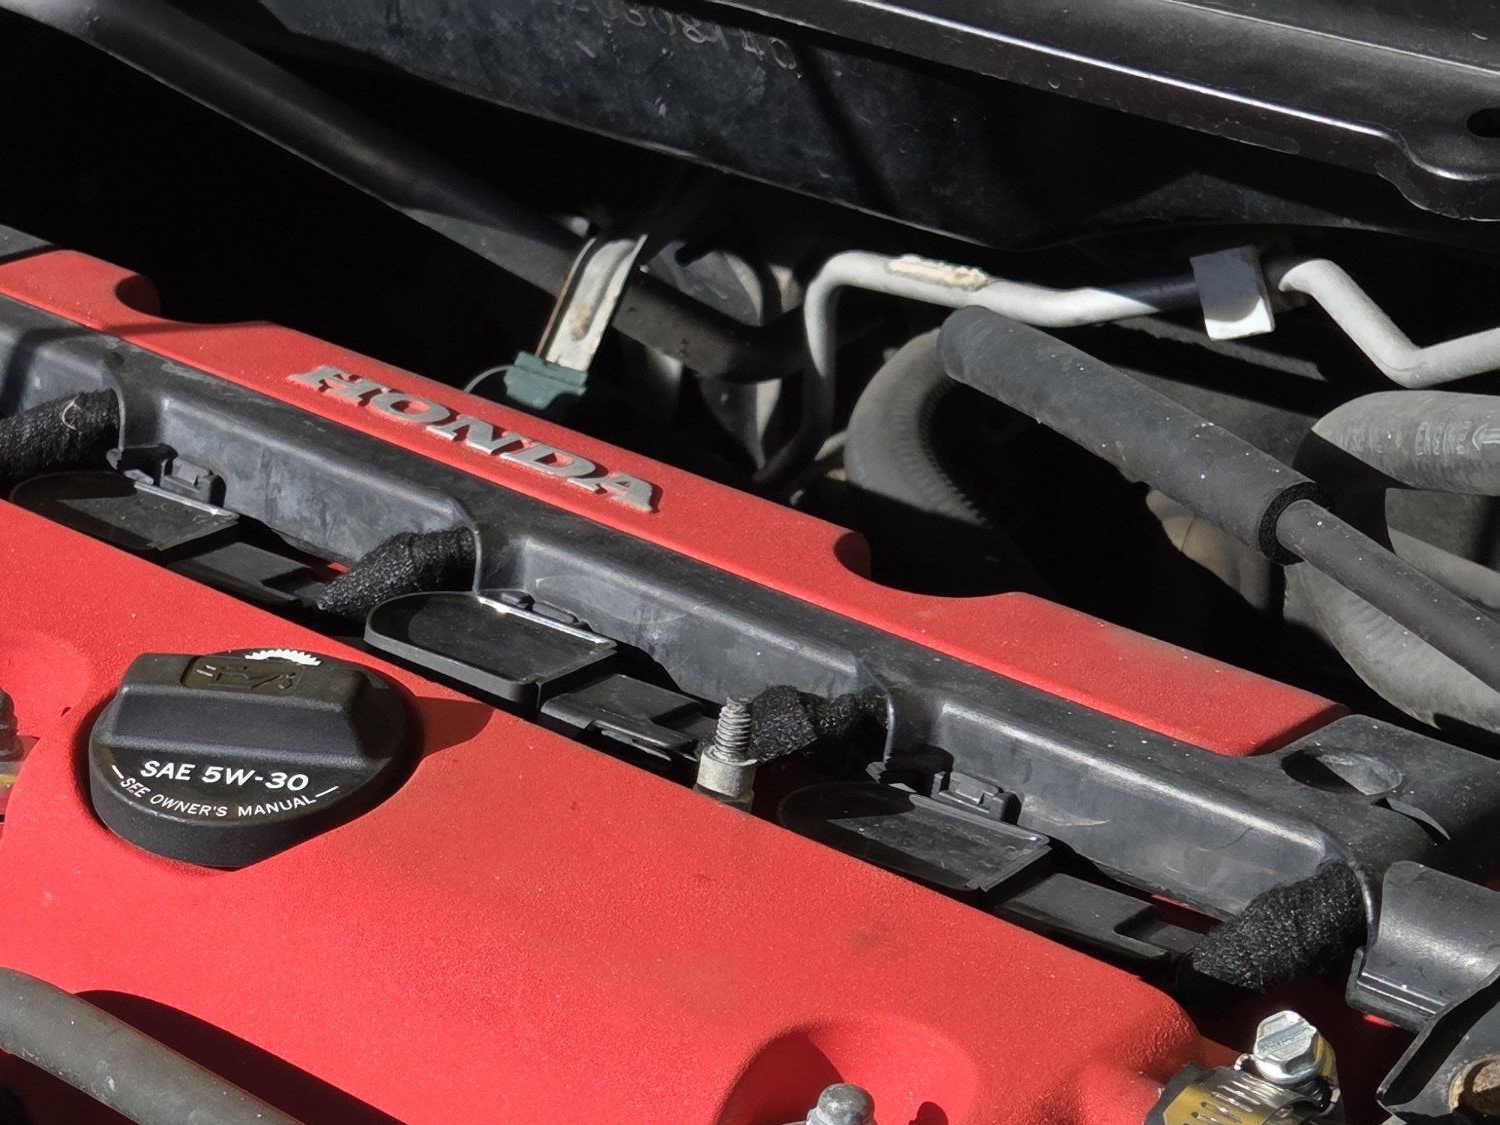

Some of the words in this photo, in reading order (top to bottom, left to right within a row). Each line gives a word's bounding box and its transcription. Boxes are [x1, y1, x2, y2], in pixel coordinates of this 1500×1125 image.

[288, 365, 654, 511] HONDA
[140, 760, 196, 781] SAE
[201, 766, 309, 791] 5W-30
[120, 777, 151, 798] SEE
[150, 793, 228, 817] OWNER'S
[237, 794, 316, 817] MANUAL
